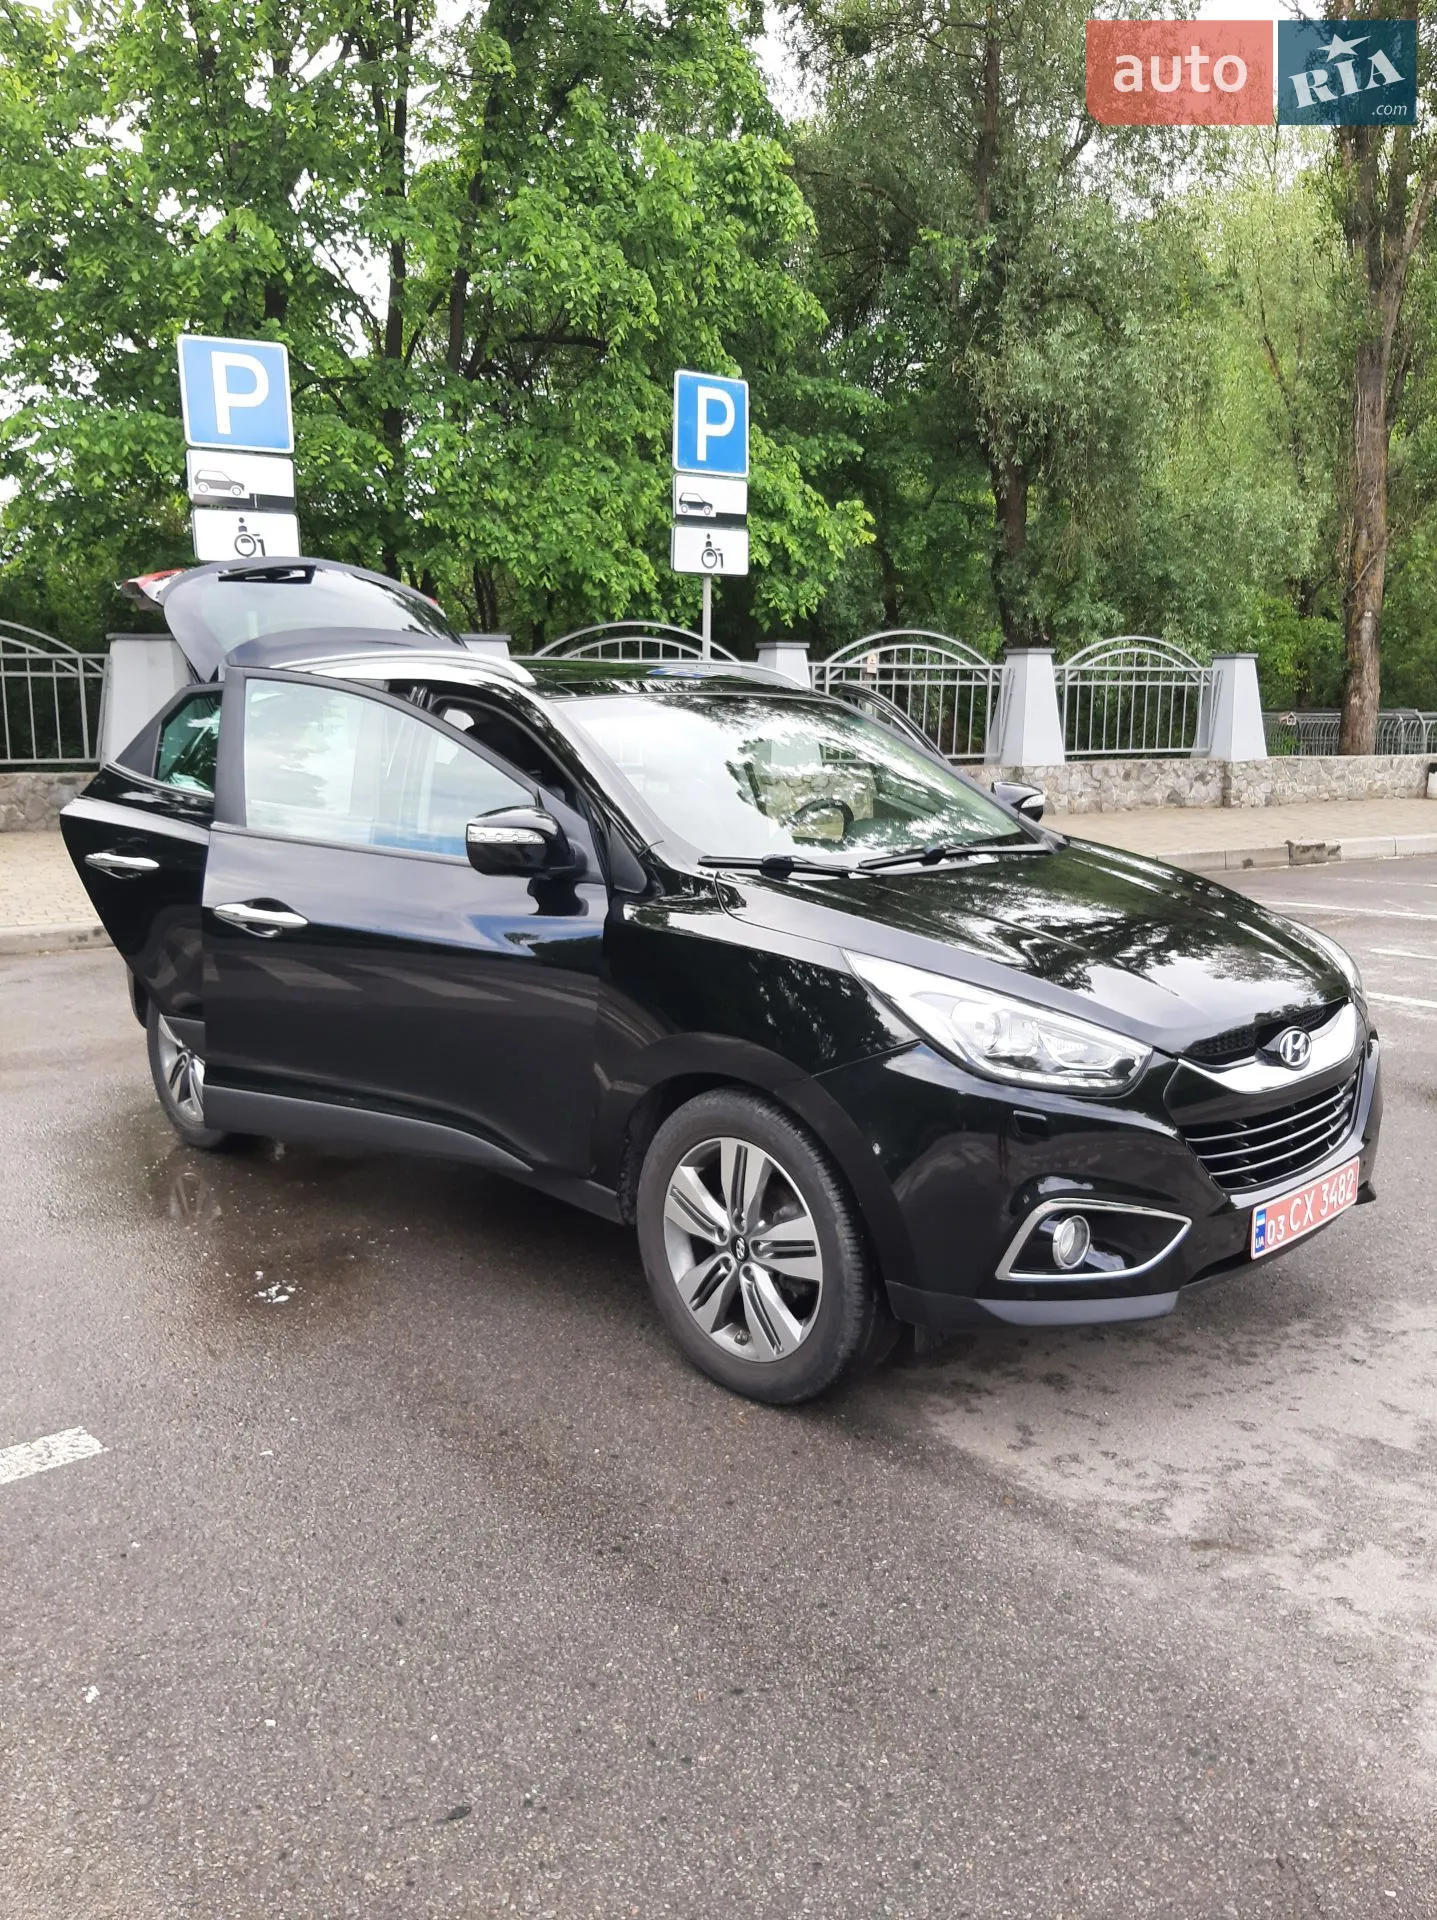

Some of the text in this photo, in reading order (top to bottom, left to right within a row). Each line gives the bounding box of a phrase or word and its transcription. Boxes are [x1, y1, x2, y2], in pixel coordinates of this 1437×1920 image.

[211, 351, 269, 435] P
[697, 385, 735, 462] P
[1255, 1236, 1265, 1249] UA
[1267, 1168, 1355, 1246] 03 CX 3482
